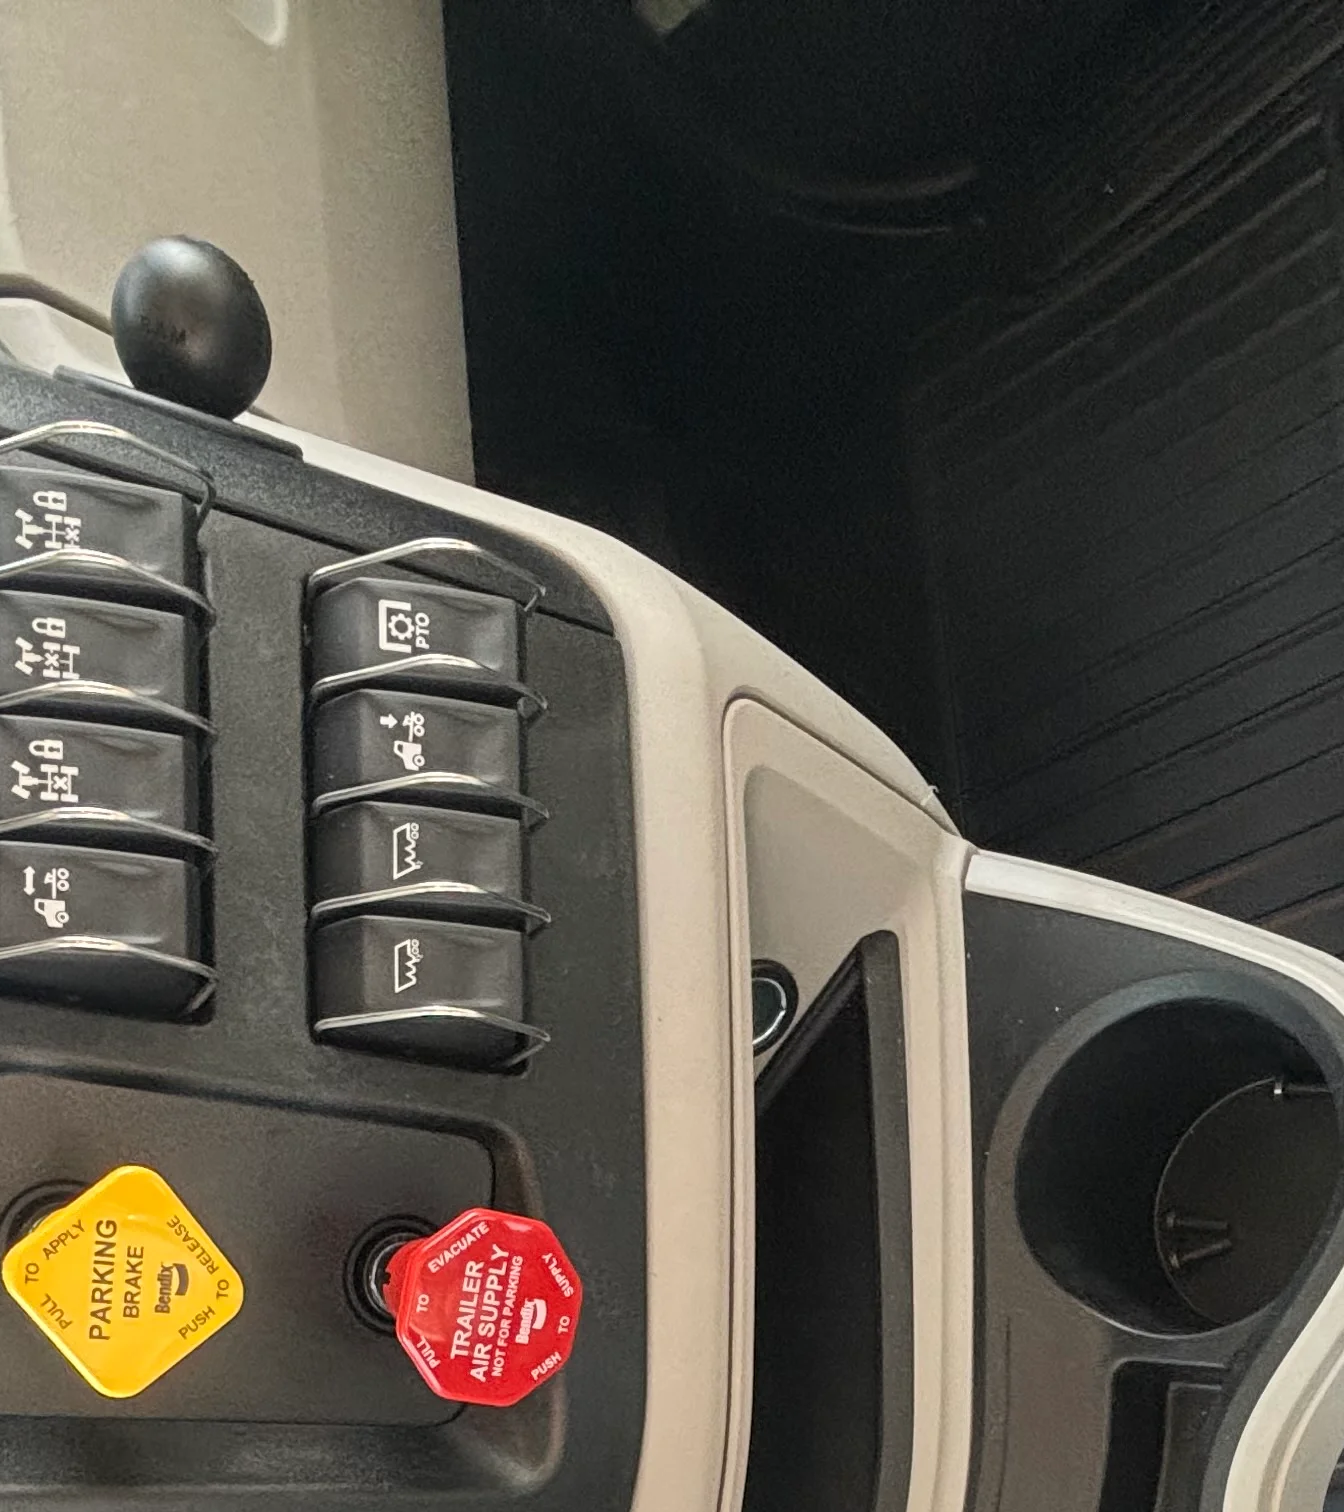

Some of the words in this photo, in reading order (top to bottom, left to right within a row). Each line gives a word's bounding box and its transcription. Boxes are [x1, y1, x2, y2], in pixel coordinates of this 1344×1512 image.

[415, 612, 430, 649] PTO
[42, 1219, 85, 1260] APPLY
[166, 1215, 219, 1275] RELEASE
[427, 1221, 490, 1274] EVACUATE
[25, 1263, 40, 1284] TO
[89, 1219, 117, 1340] PARKING
[123, 1246, 144, 1318] BRAKE
[154, 1264, 174, 1314] Bendix
[216, 1279, 229, 1299] TO
[477, 1244, 510, 1338] SUPPLY
[502, 1255, 524, 1316] PARKING
[541, 1252, 575, 1297] SUPPLY
[40, 1293, 72, 1329] PULL
[178, 1306, 216, 1339] PUSH
[416, 1294, 430, 1313] TO
[450, 1261, 484, 1359] TRAILER
[515, 1298, 535, 1344] Bendix
[496, 1319, 512, 1347] FOR
[557, 1316, 571, 1334] TO
[416, 1335, 441, 1369] PULL
[470, 1343, 493, 1382] AIR
[491, 1349, 506, 1377] NOT
[531, 1351, 562, 1381] PUSH
